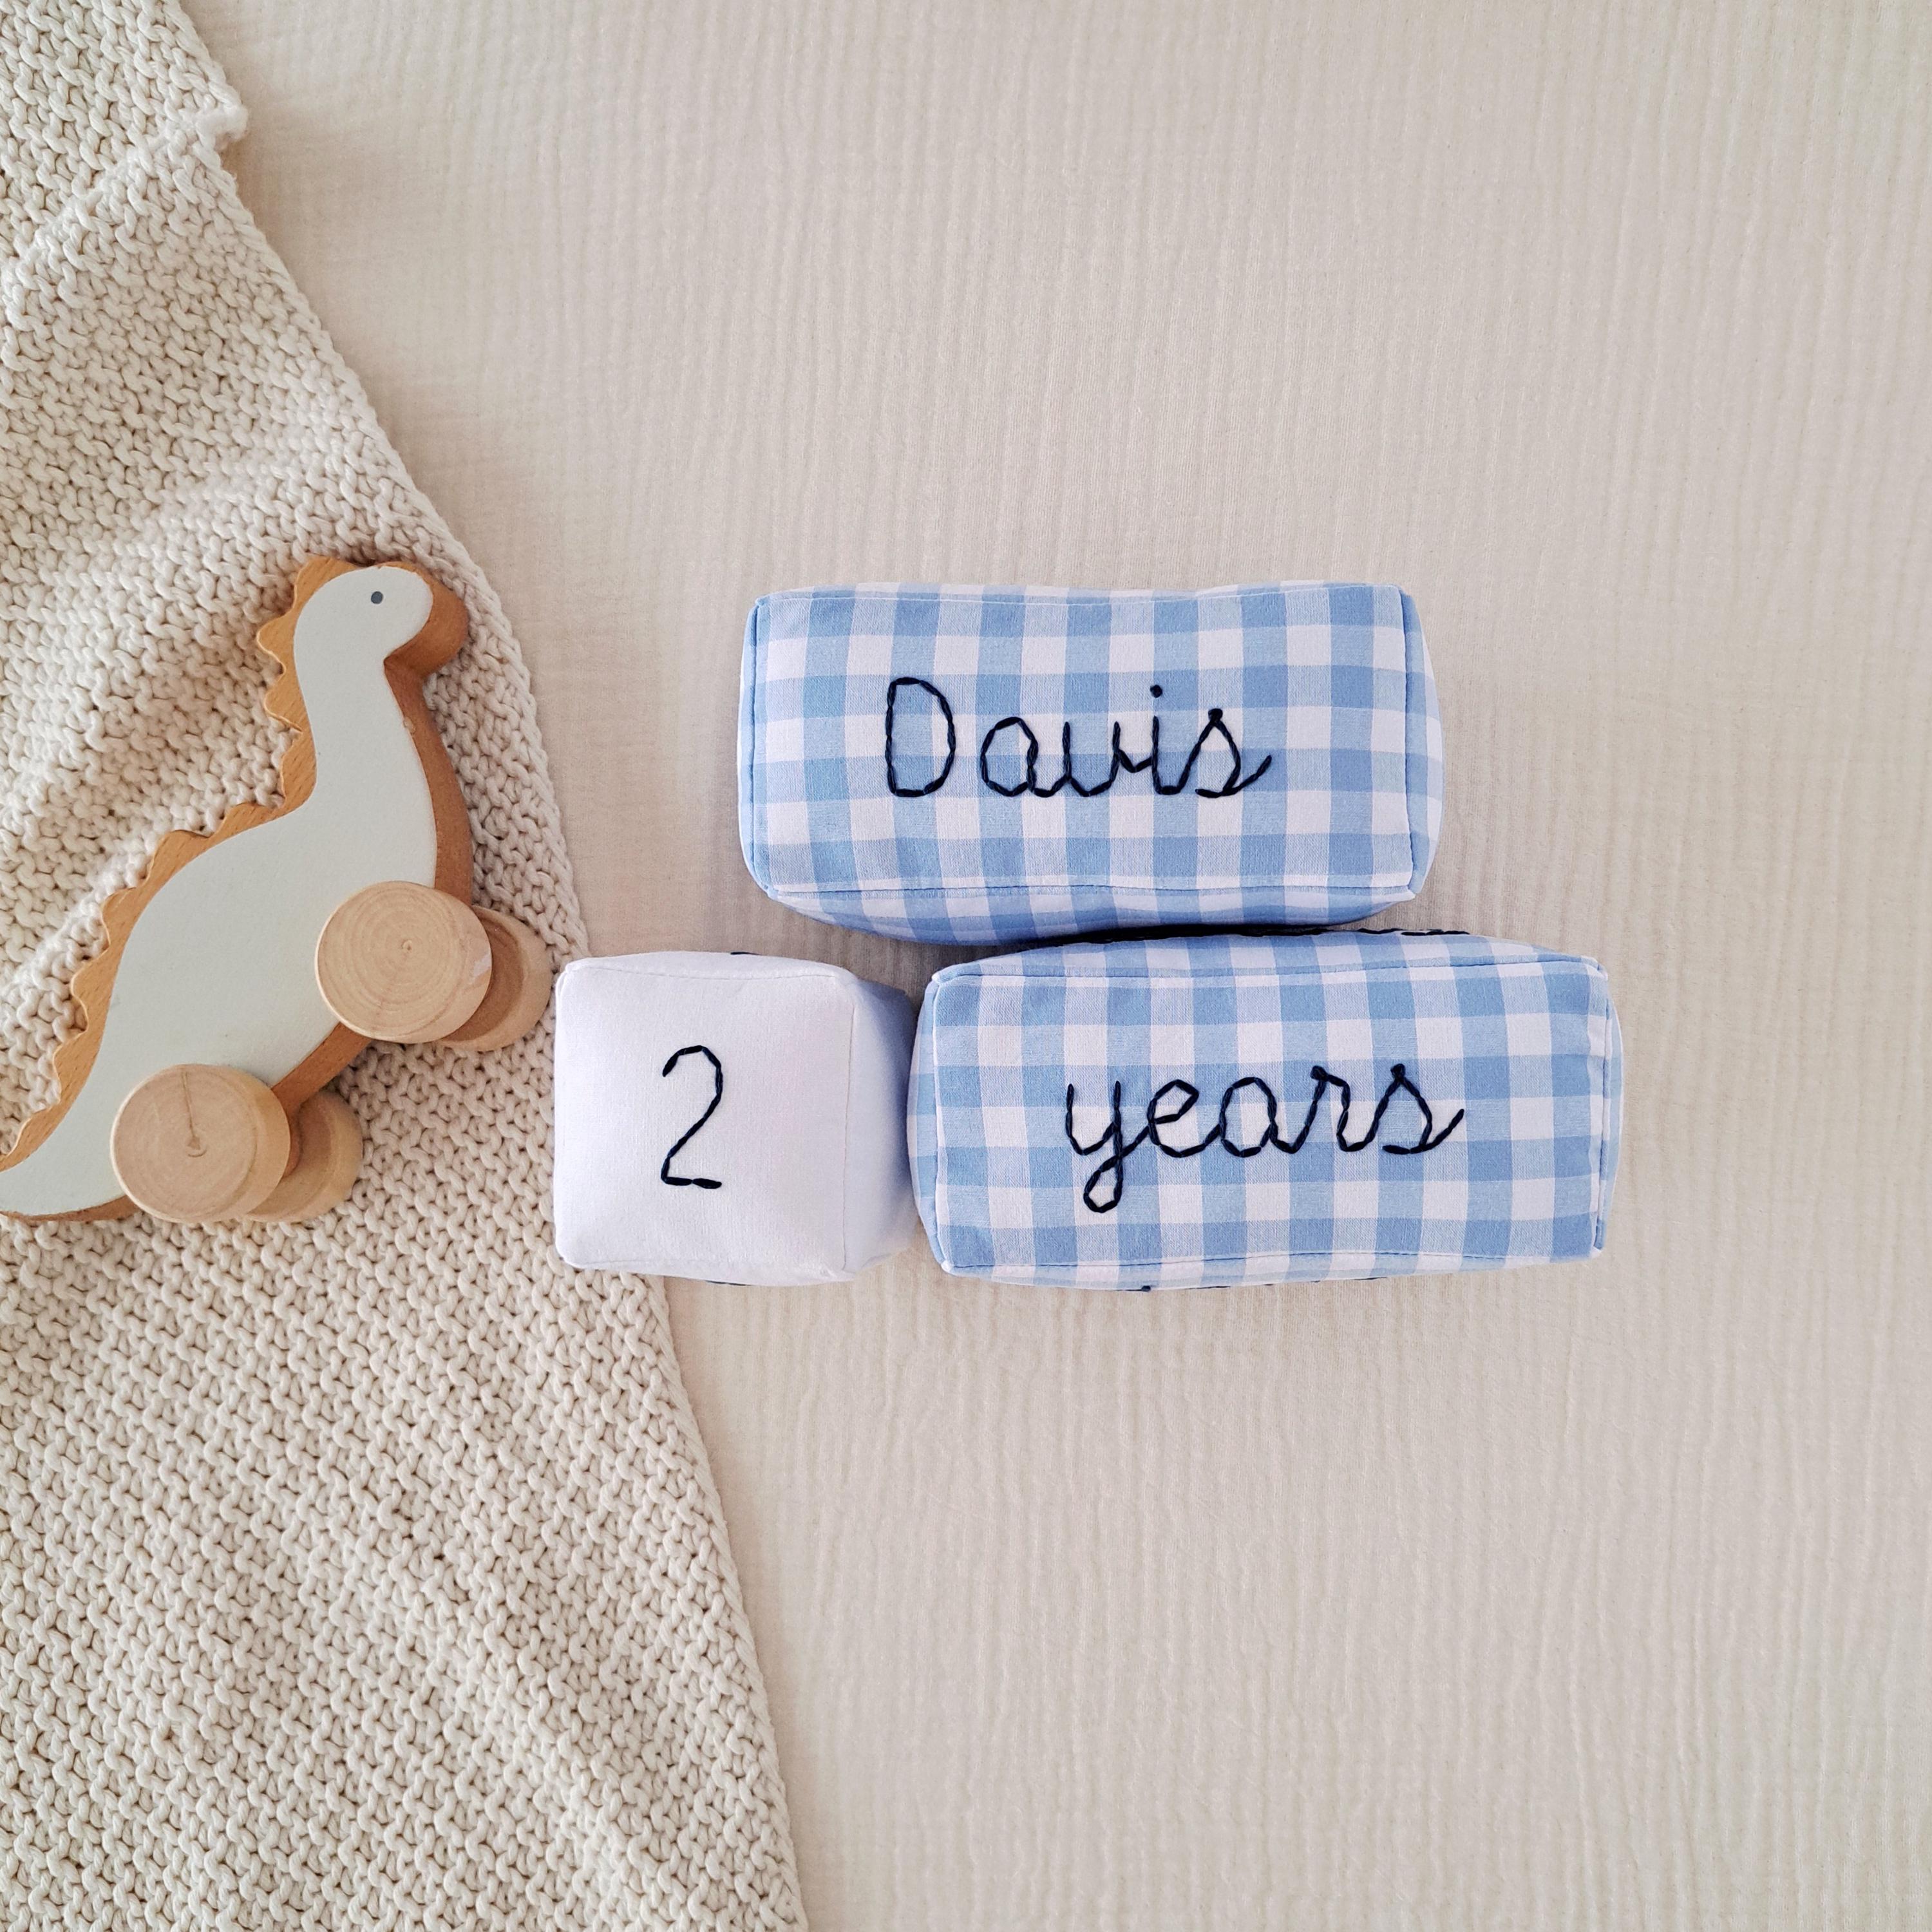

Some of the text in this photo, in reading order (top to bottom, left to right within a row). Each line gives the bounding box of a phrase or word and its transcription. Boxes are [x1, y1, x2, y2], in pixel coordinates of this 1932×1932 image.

[884, 676, 1273, 799] Davis
[661, 1045, 723, 1189] 2
[1065, 1063, 1464, 1214] years
